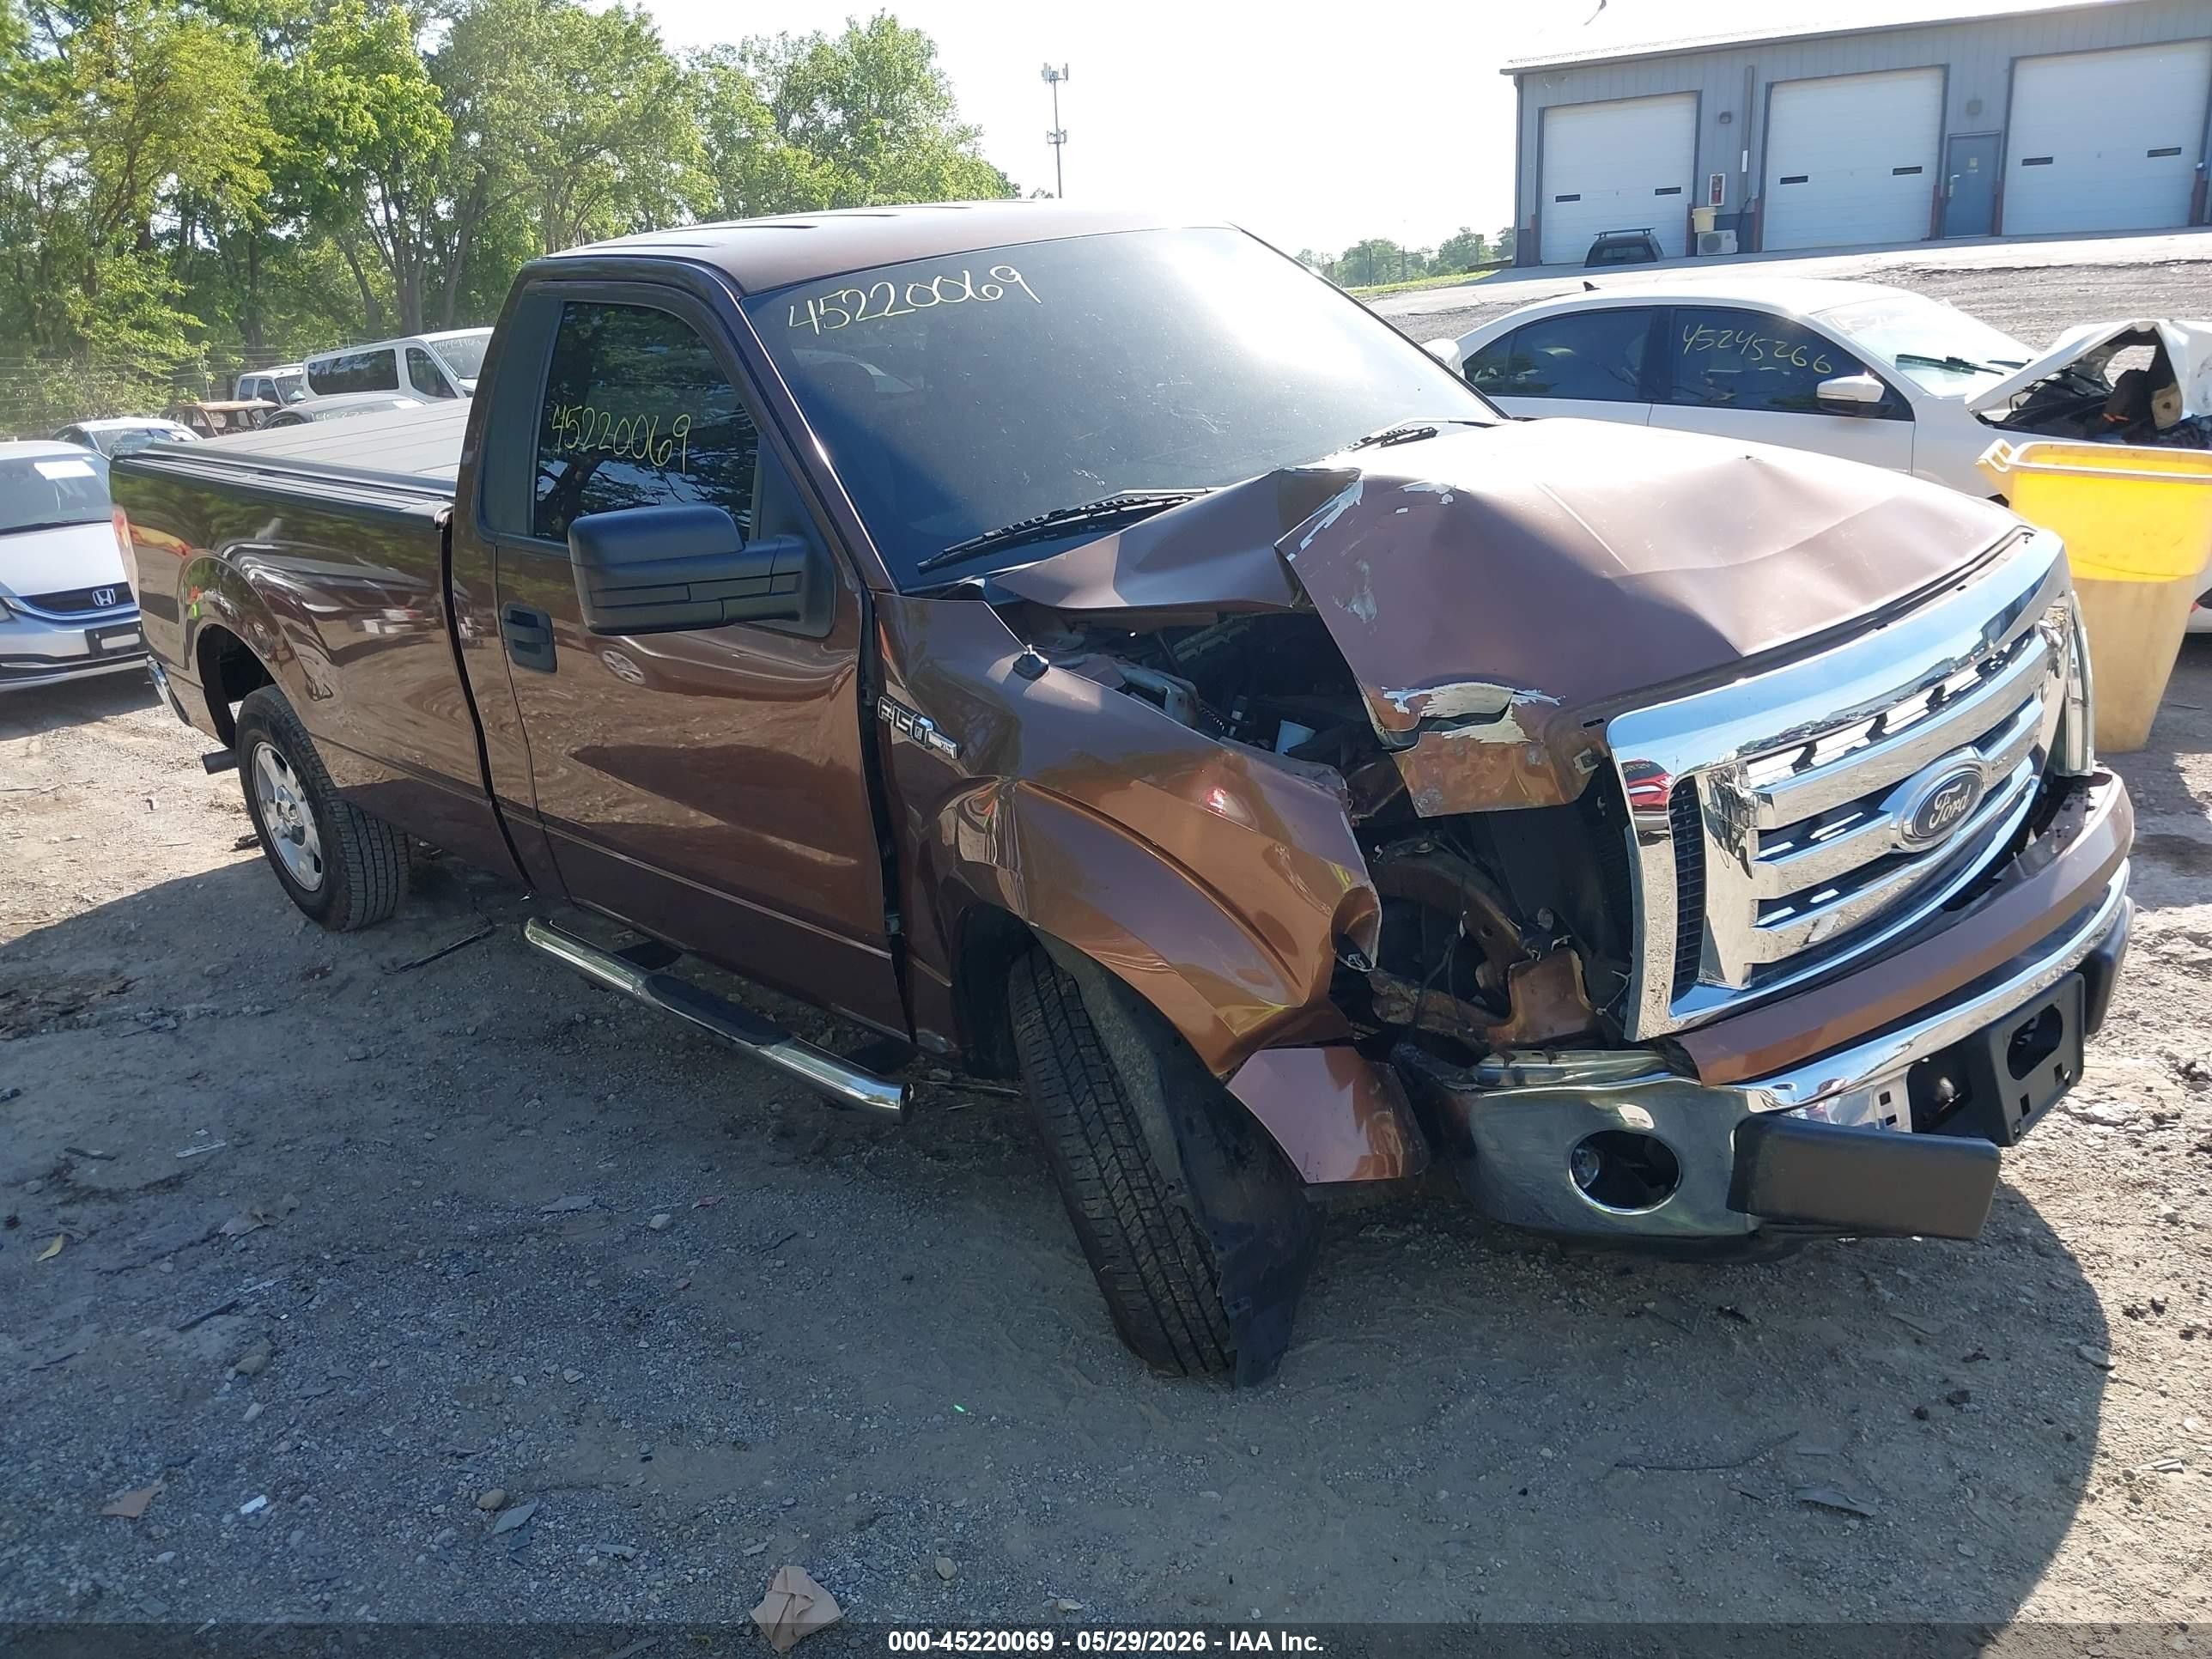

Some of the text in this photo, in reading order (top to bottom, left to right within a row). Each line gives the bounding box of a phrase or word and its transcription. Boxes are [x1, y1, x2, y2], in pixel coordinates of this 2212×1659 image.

[788, 265, 1042, 336] 45220069
[1682, 323, 1832, 374] 45245266
[551, 404, 691, 476] 45220069
[1929, 782, 1972, 830] Ford
